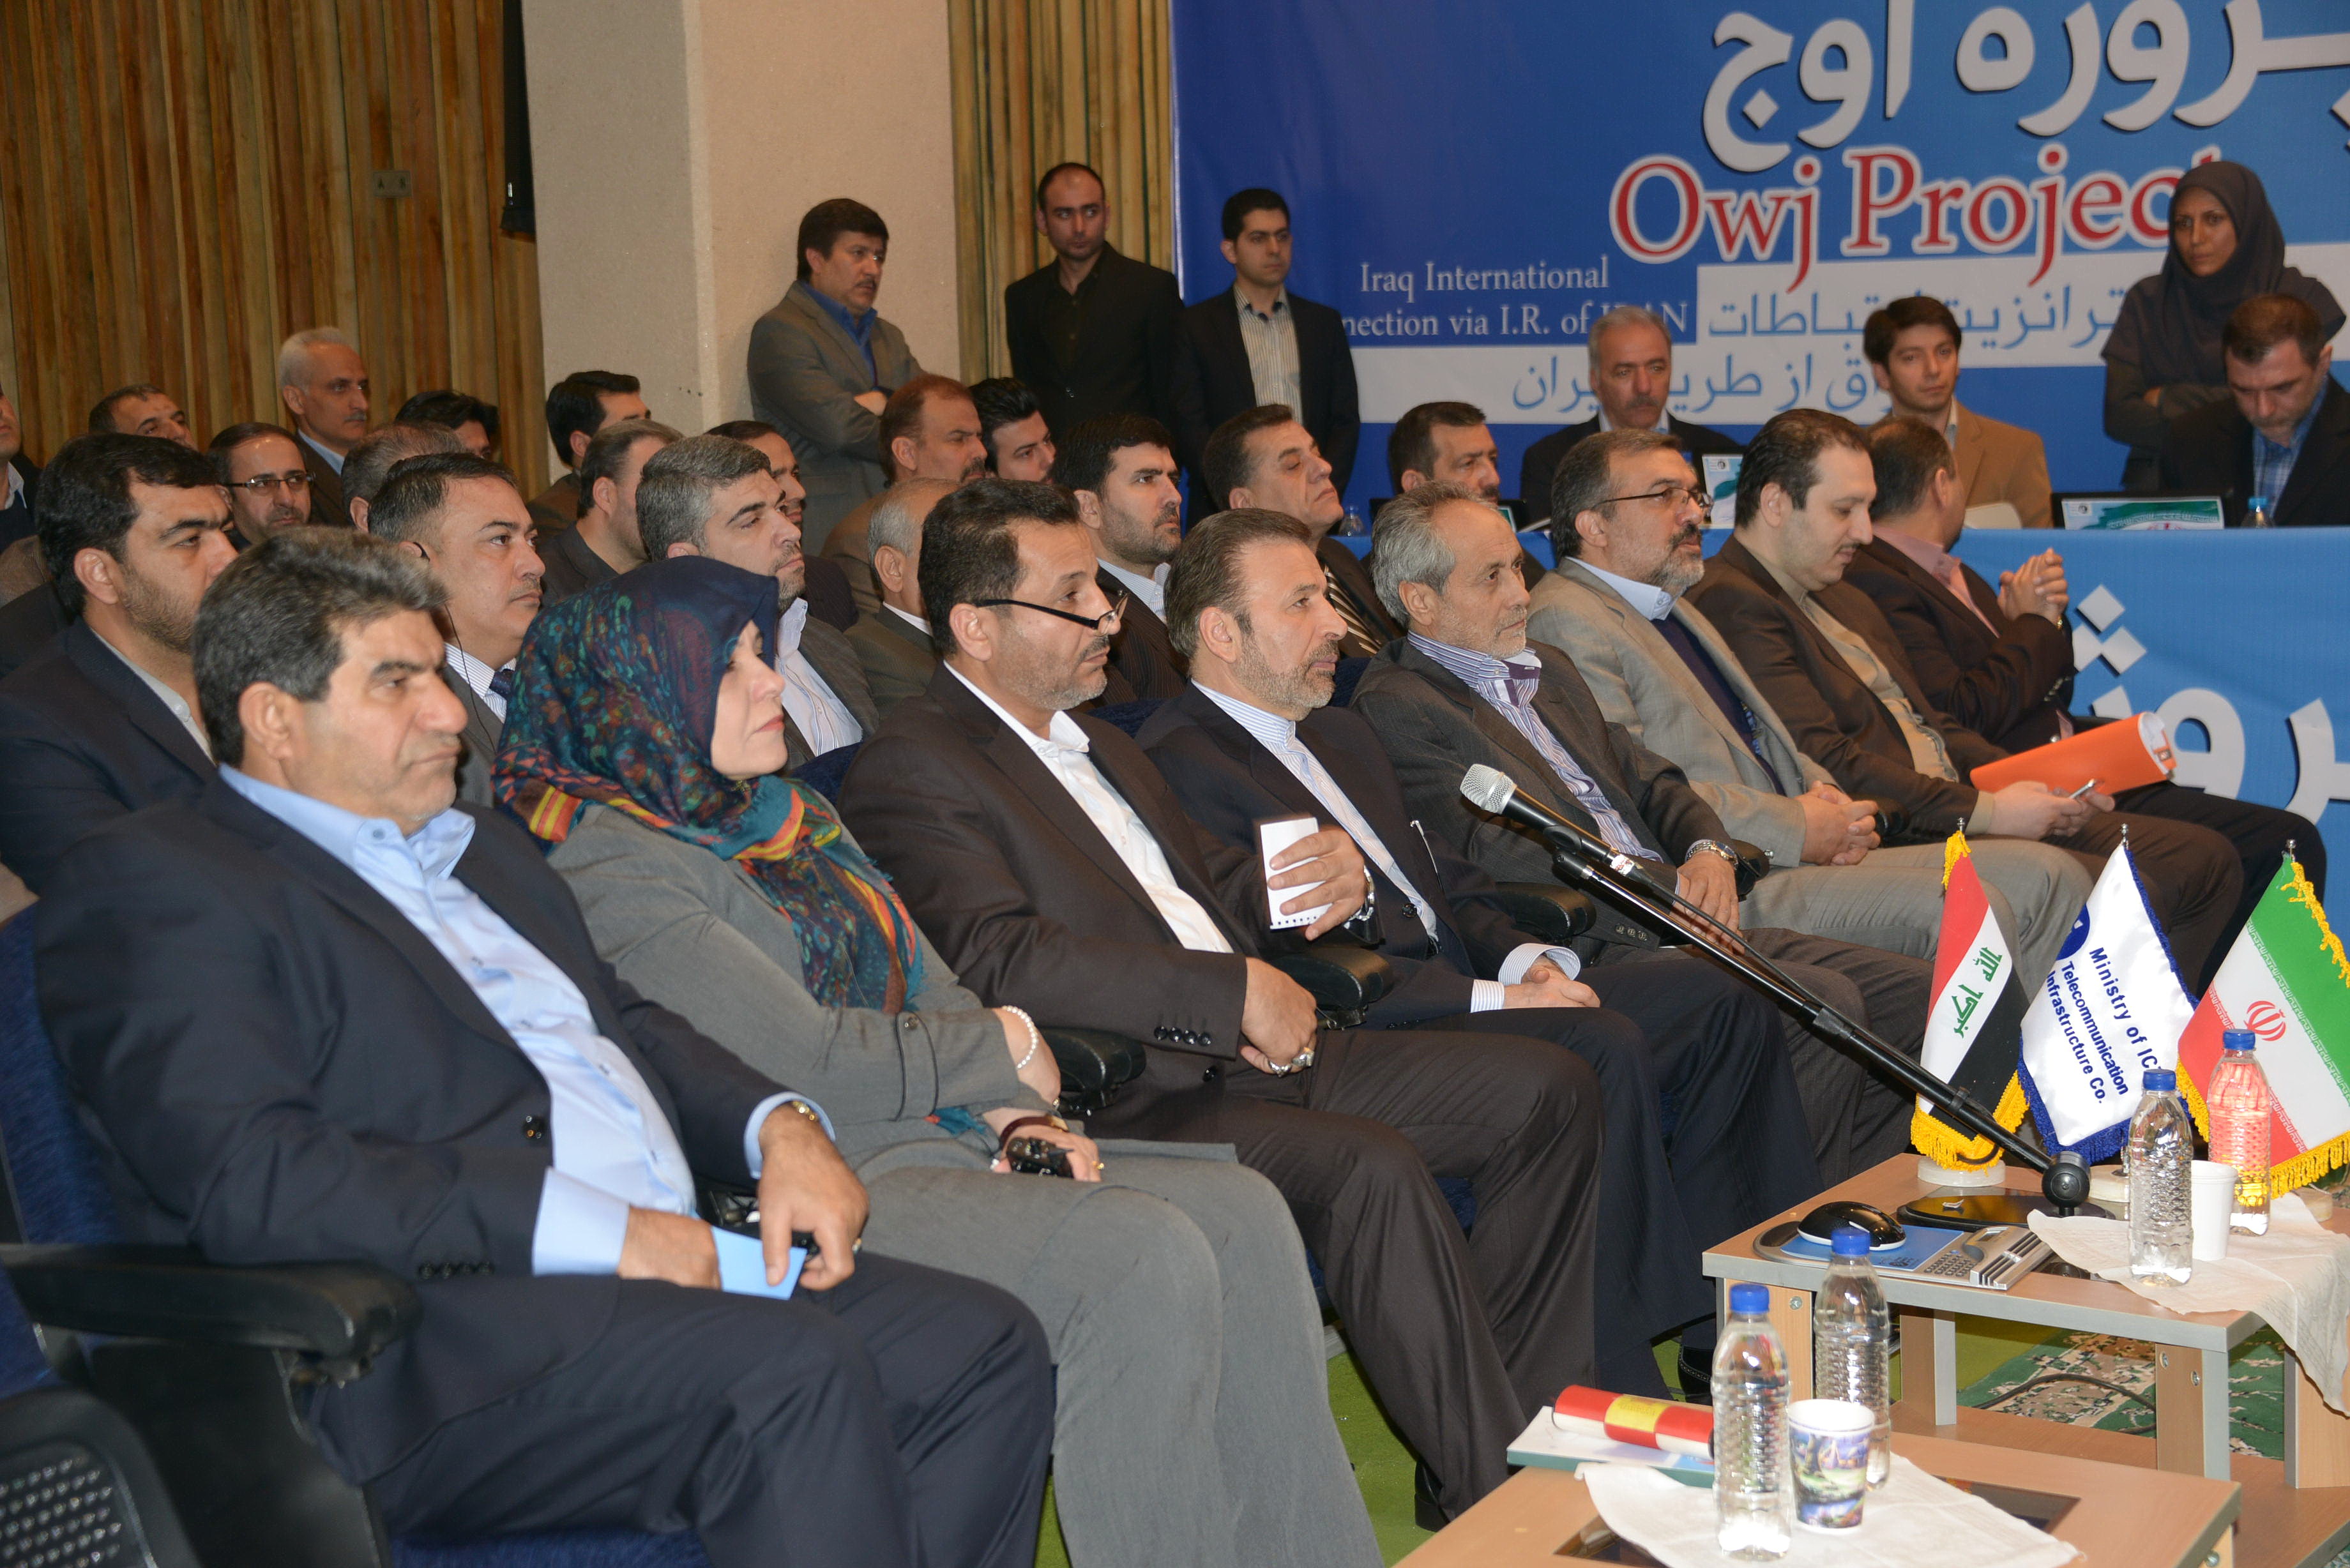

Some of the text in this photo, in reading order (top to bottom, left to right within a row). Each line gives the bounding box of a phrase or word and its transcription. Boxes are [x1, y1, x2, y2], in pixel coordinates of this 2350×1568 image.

[1702, 0, 1914, 174] اوج
[1361, 255, 1609, 303] Iraq International
[1611, 146, 2217, 294] Owj Projec
[1342, 308, 1439, 336] nection
[1450, 307, 1489, 336] via
[1501, 305, 1550, 335] I.R.
[1561, 300, 1595, 335] of
[1669, 352, 1762, 413] طری
[1773, 352, 1812, 412] از
[2046, 970, 2106, 1104] Infrastructure Co.
[2061, 960, 2129, 1096] Telecommunication
[2089, 947, 2162, 1070] Ministry of IC
